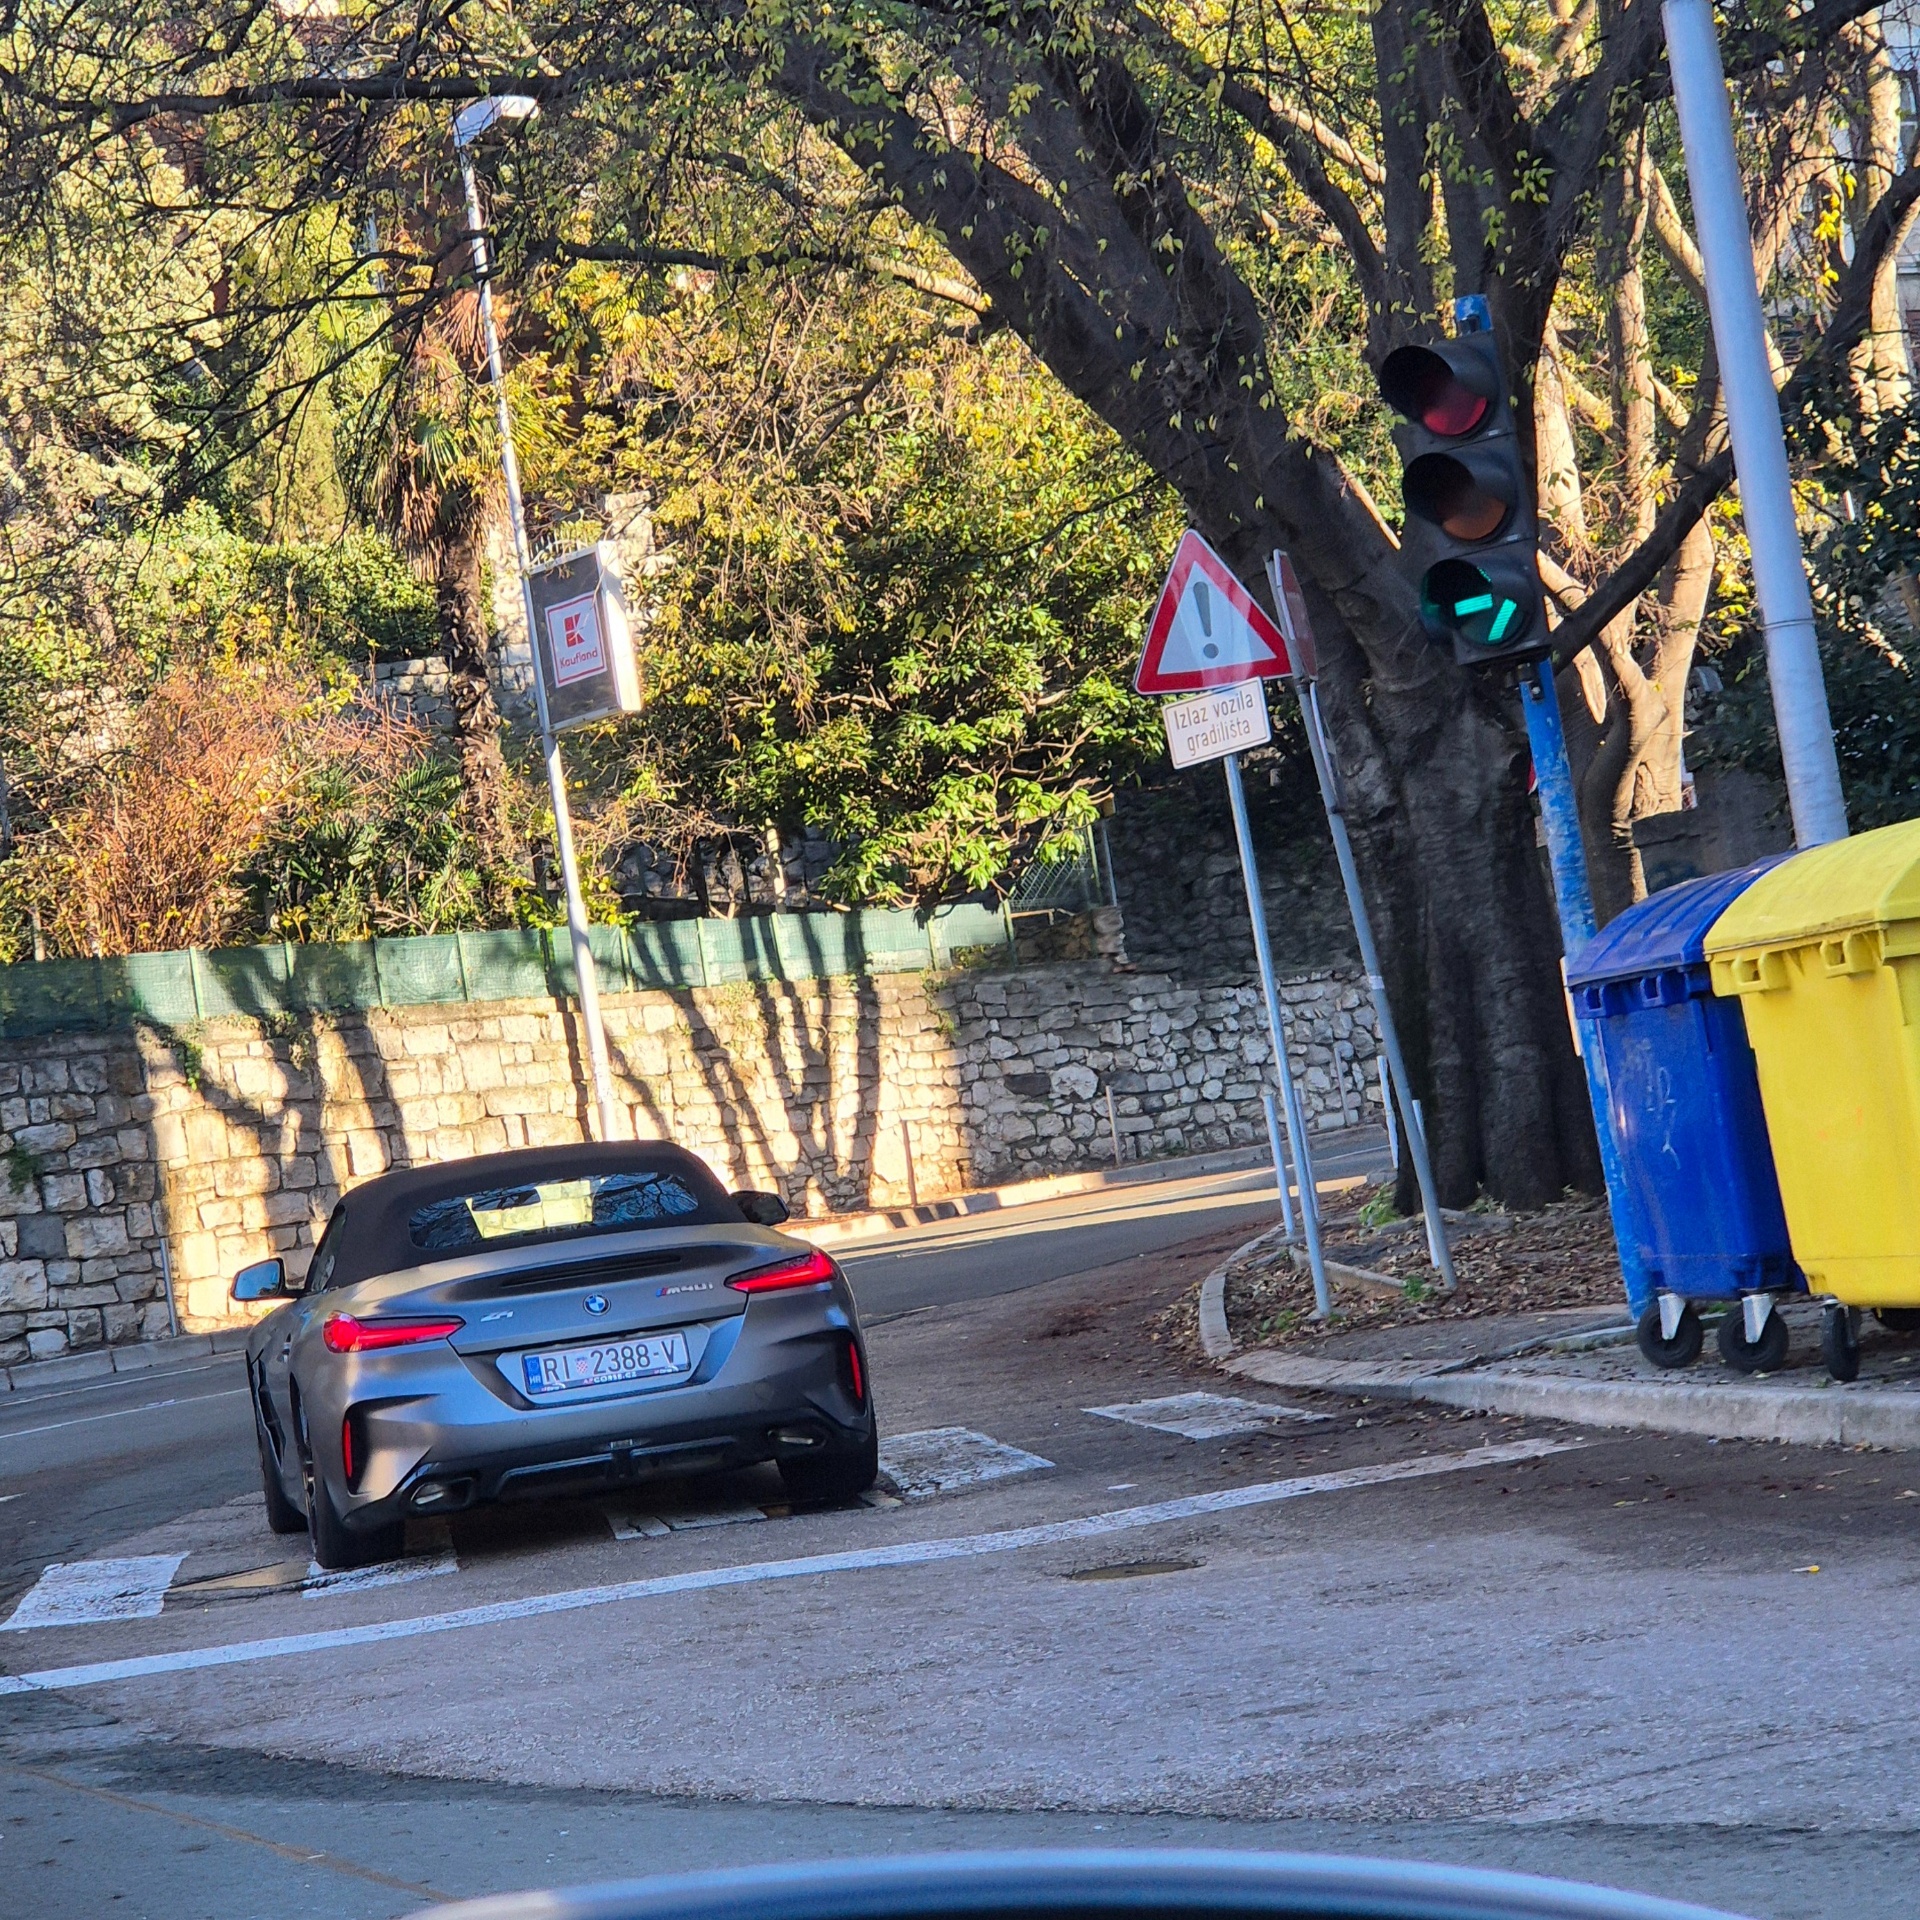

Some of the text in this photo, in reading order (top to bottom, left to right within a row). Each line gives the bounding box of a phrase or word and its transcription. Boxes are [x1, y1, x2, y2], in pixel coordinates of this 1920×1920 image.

[560, 647, 598, 668] Kaufland
[1174, 690, 1254, 730] Izlaz vozila
[1187, 718, 1251, 757] gradilišta
[529, 1375, 541, 1384] HR
[543, 1340, 674, 1382] RI 2388-V
